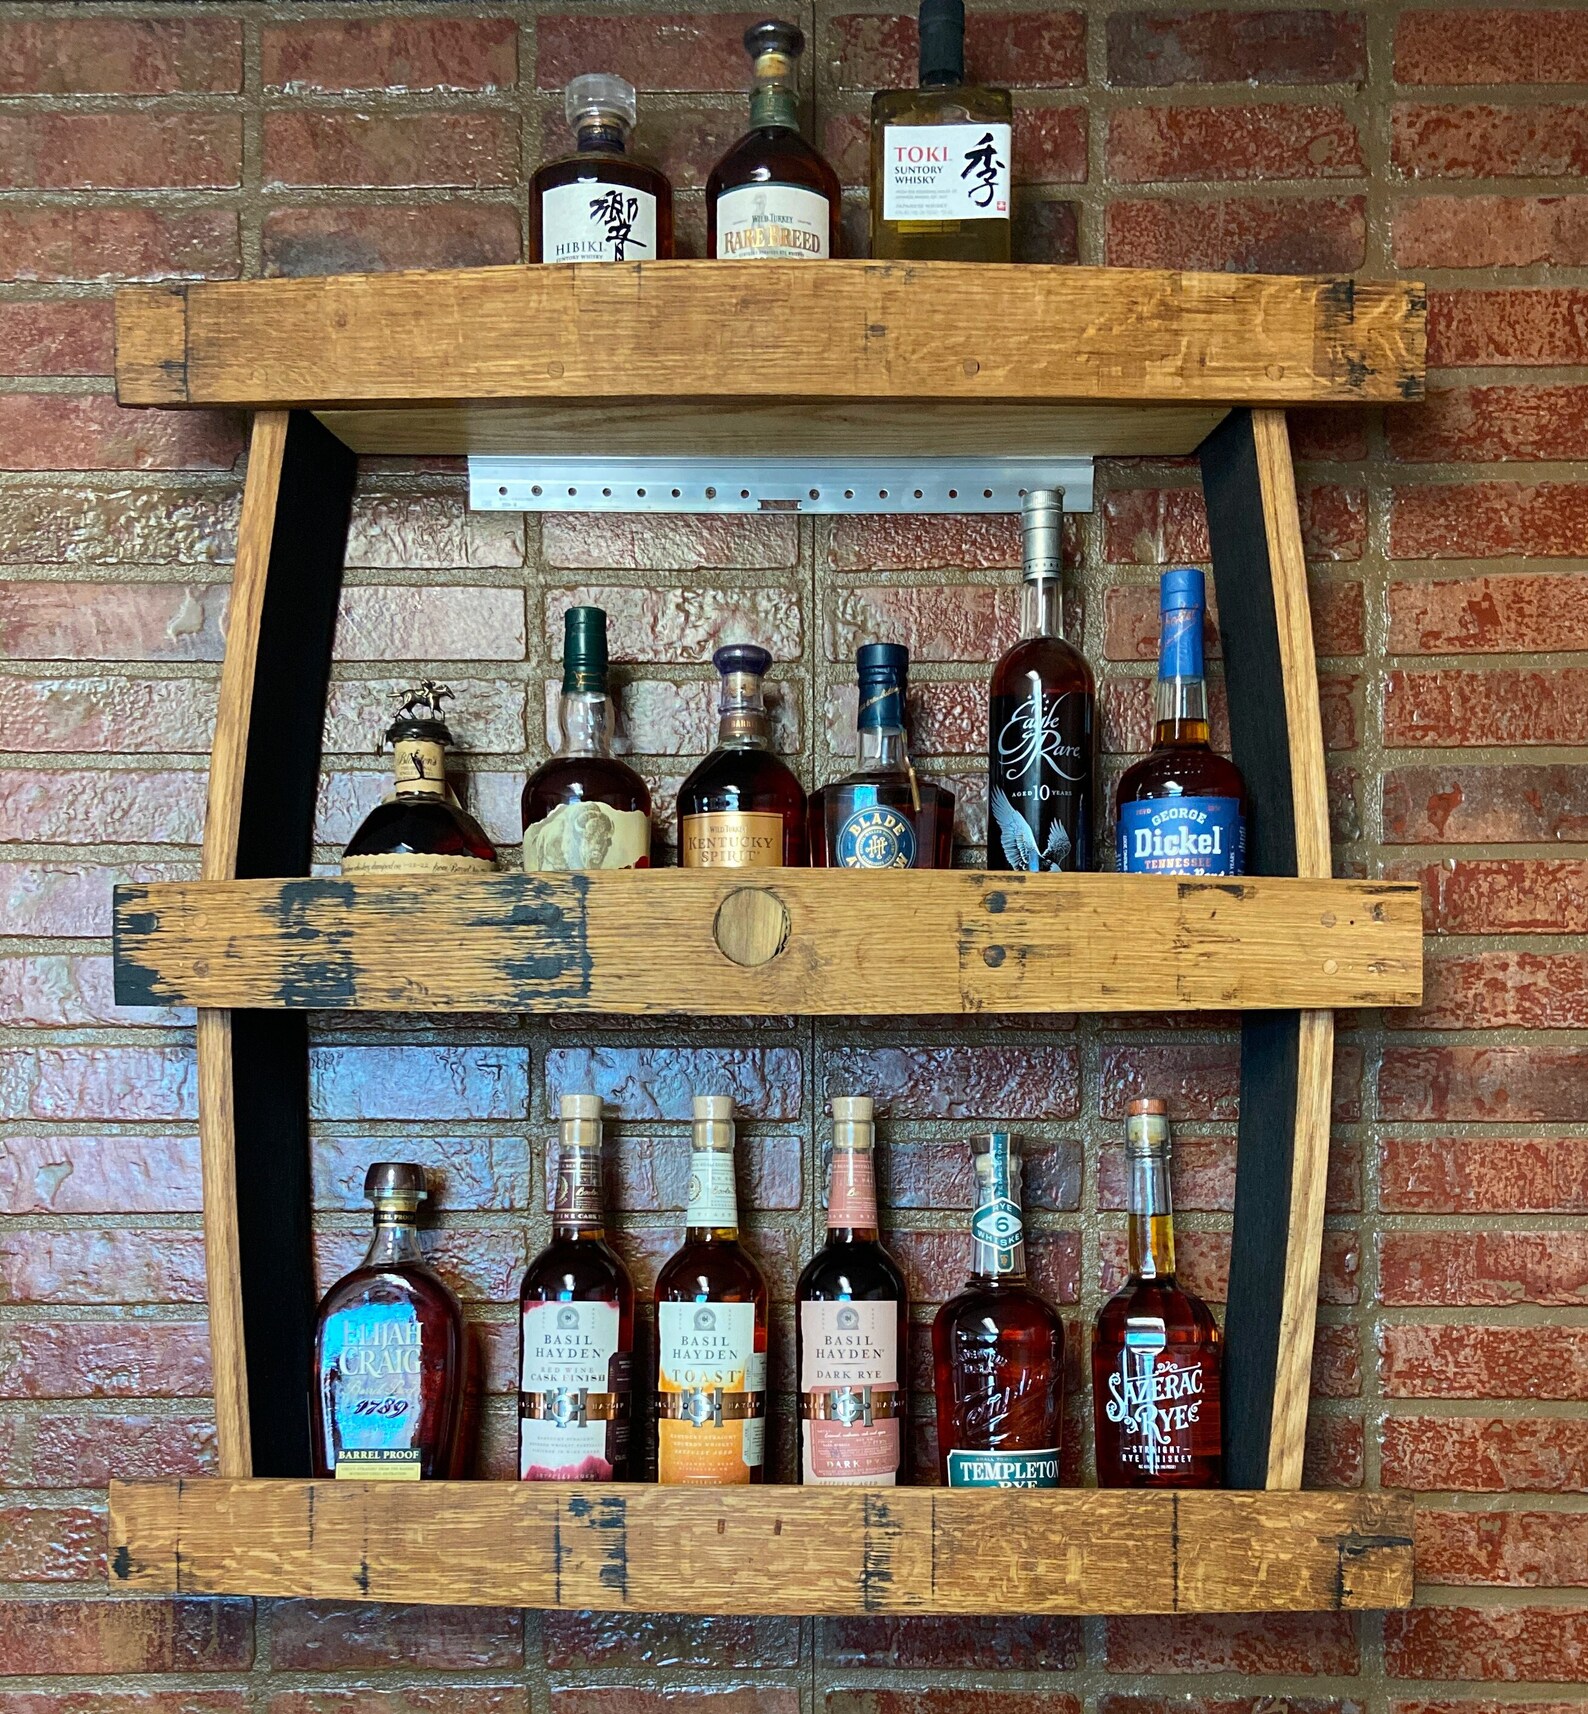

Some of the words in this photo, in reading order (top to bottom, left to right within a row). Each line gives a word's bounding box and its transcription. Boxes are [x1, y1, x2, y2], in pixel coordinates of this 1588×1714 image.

[893, 146, 948, 163] TOKI
[894, 165, 944, 175] SUNTORY
[960, 132, 1006, 208] 季
[894, 175, 936, 184] WHISKY
[751, 214, 769, 224] WILD
[769, 213, 793, 223] TURKEY
[723, 227, 766, 255] RARE
[767, 224, 821, 254] BREED
[556, 241, 603, 256] HIBIKI
[999, 729, 1086, 781] Rare
[1032, 784, 1050, 801] 10
[1151, 807, 1208, 827] GEORGE
[709, 825, 725, 833] WILD
[848, 812, 906, 837] BLADE
[688, 836, 774, 851] KENTUCKY
[1134, 825, 1222, 858] Dickel
[701, 850, 757, 863] SPIRIT
[1144, 857, 1212, 870] TENNESSEE
[993, 1203, 1012, 1213] RYE
[995, 1216, 1010, 1233] 6
[342, 1320, 424, 1350] ELIJAH
[544, 1335, 593, 1345] BASIL
[681, 1336, 730, 1346] BASIL
[824, 1335, 874, 1346] BASIL
[535, 1348, 601, 1359] HAYDEN
[672, 1349, 738, 1360] HAYDEN
[816, 1348, 882, 1359] HAYDEN
[339, 1346, 423, 1379] CRAIG
[530, 1373, 558, 1382] CASK
[562, 1374, 606, 1382] FINISH
[672, 1369, 737, 1383] TOAST
[816, 1370, 851, 1379] DARK
[858, 1370, 882, 1379] RYE
[1106, 1368, 1203, 1422] SAZERAC
[353, 1397, 409, 1419] 1789
[1134, 1404, 1190, 1444] RYE
[338, 1451, 381, 1460] BARREL
[383, 1451, 420, 1460] PROOF
[1121, 1453, 1140, 1463] RYE
[826, 1460, 860, 1469] DARK
[960, 1460, 1059, 1482] TEMPLETON
